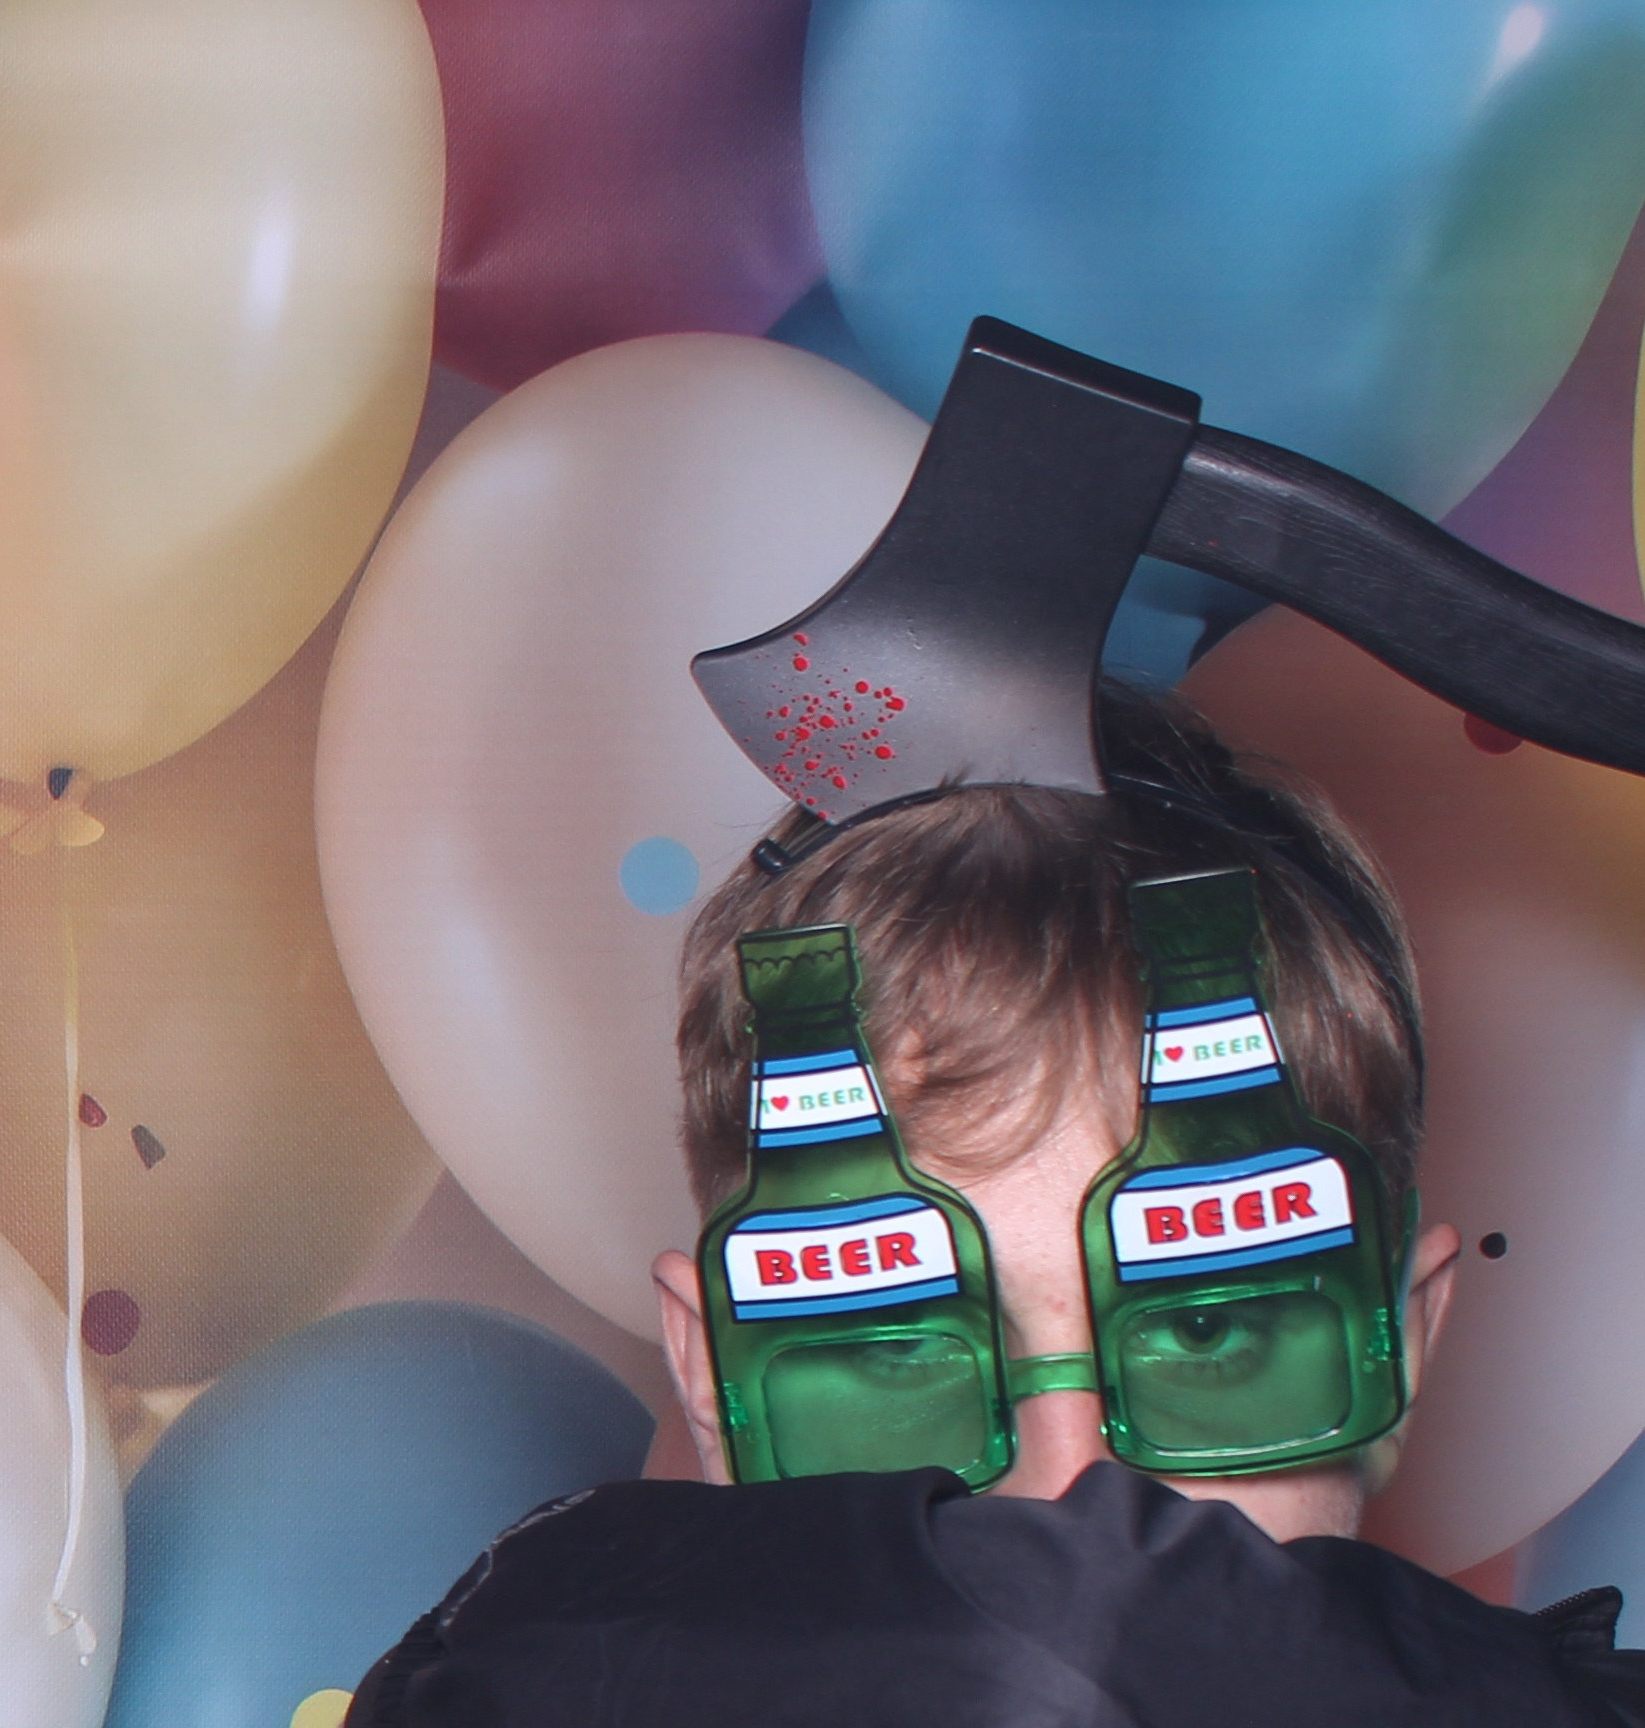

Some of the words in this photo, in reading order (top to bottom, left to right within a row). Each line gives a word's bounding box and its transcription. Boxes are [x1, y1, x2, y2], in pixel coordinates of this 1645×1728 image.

[1193, 1034, 1263, 1061] BEER
[798, 1086, 866, 1111] BEER
[1143, 1181, 1318, 1245] BEER
[754, 1231, 923, 1286] BEER
